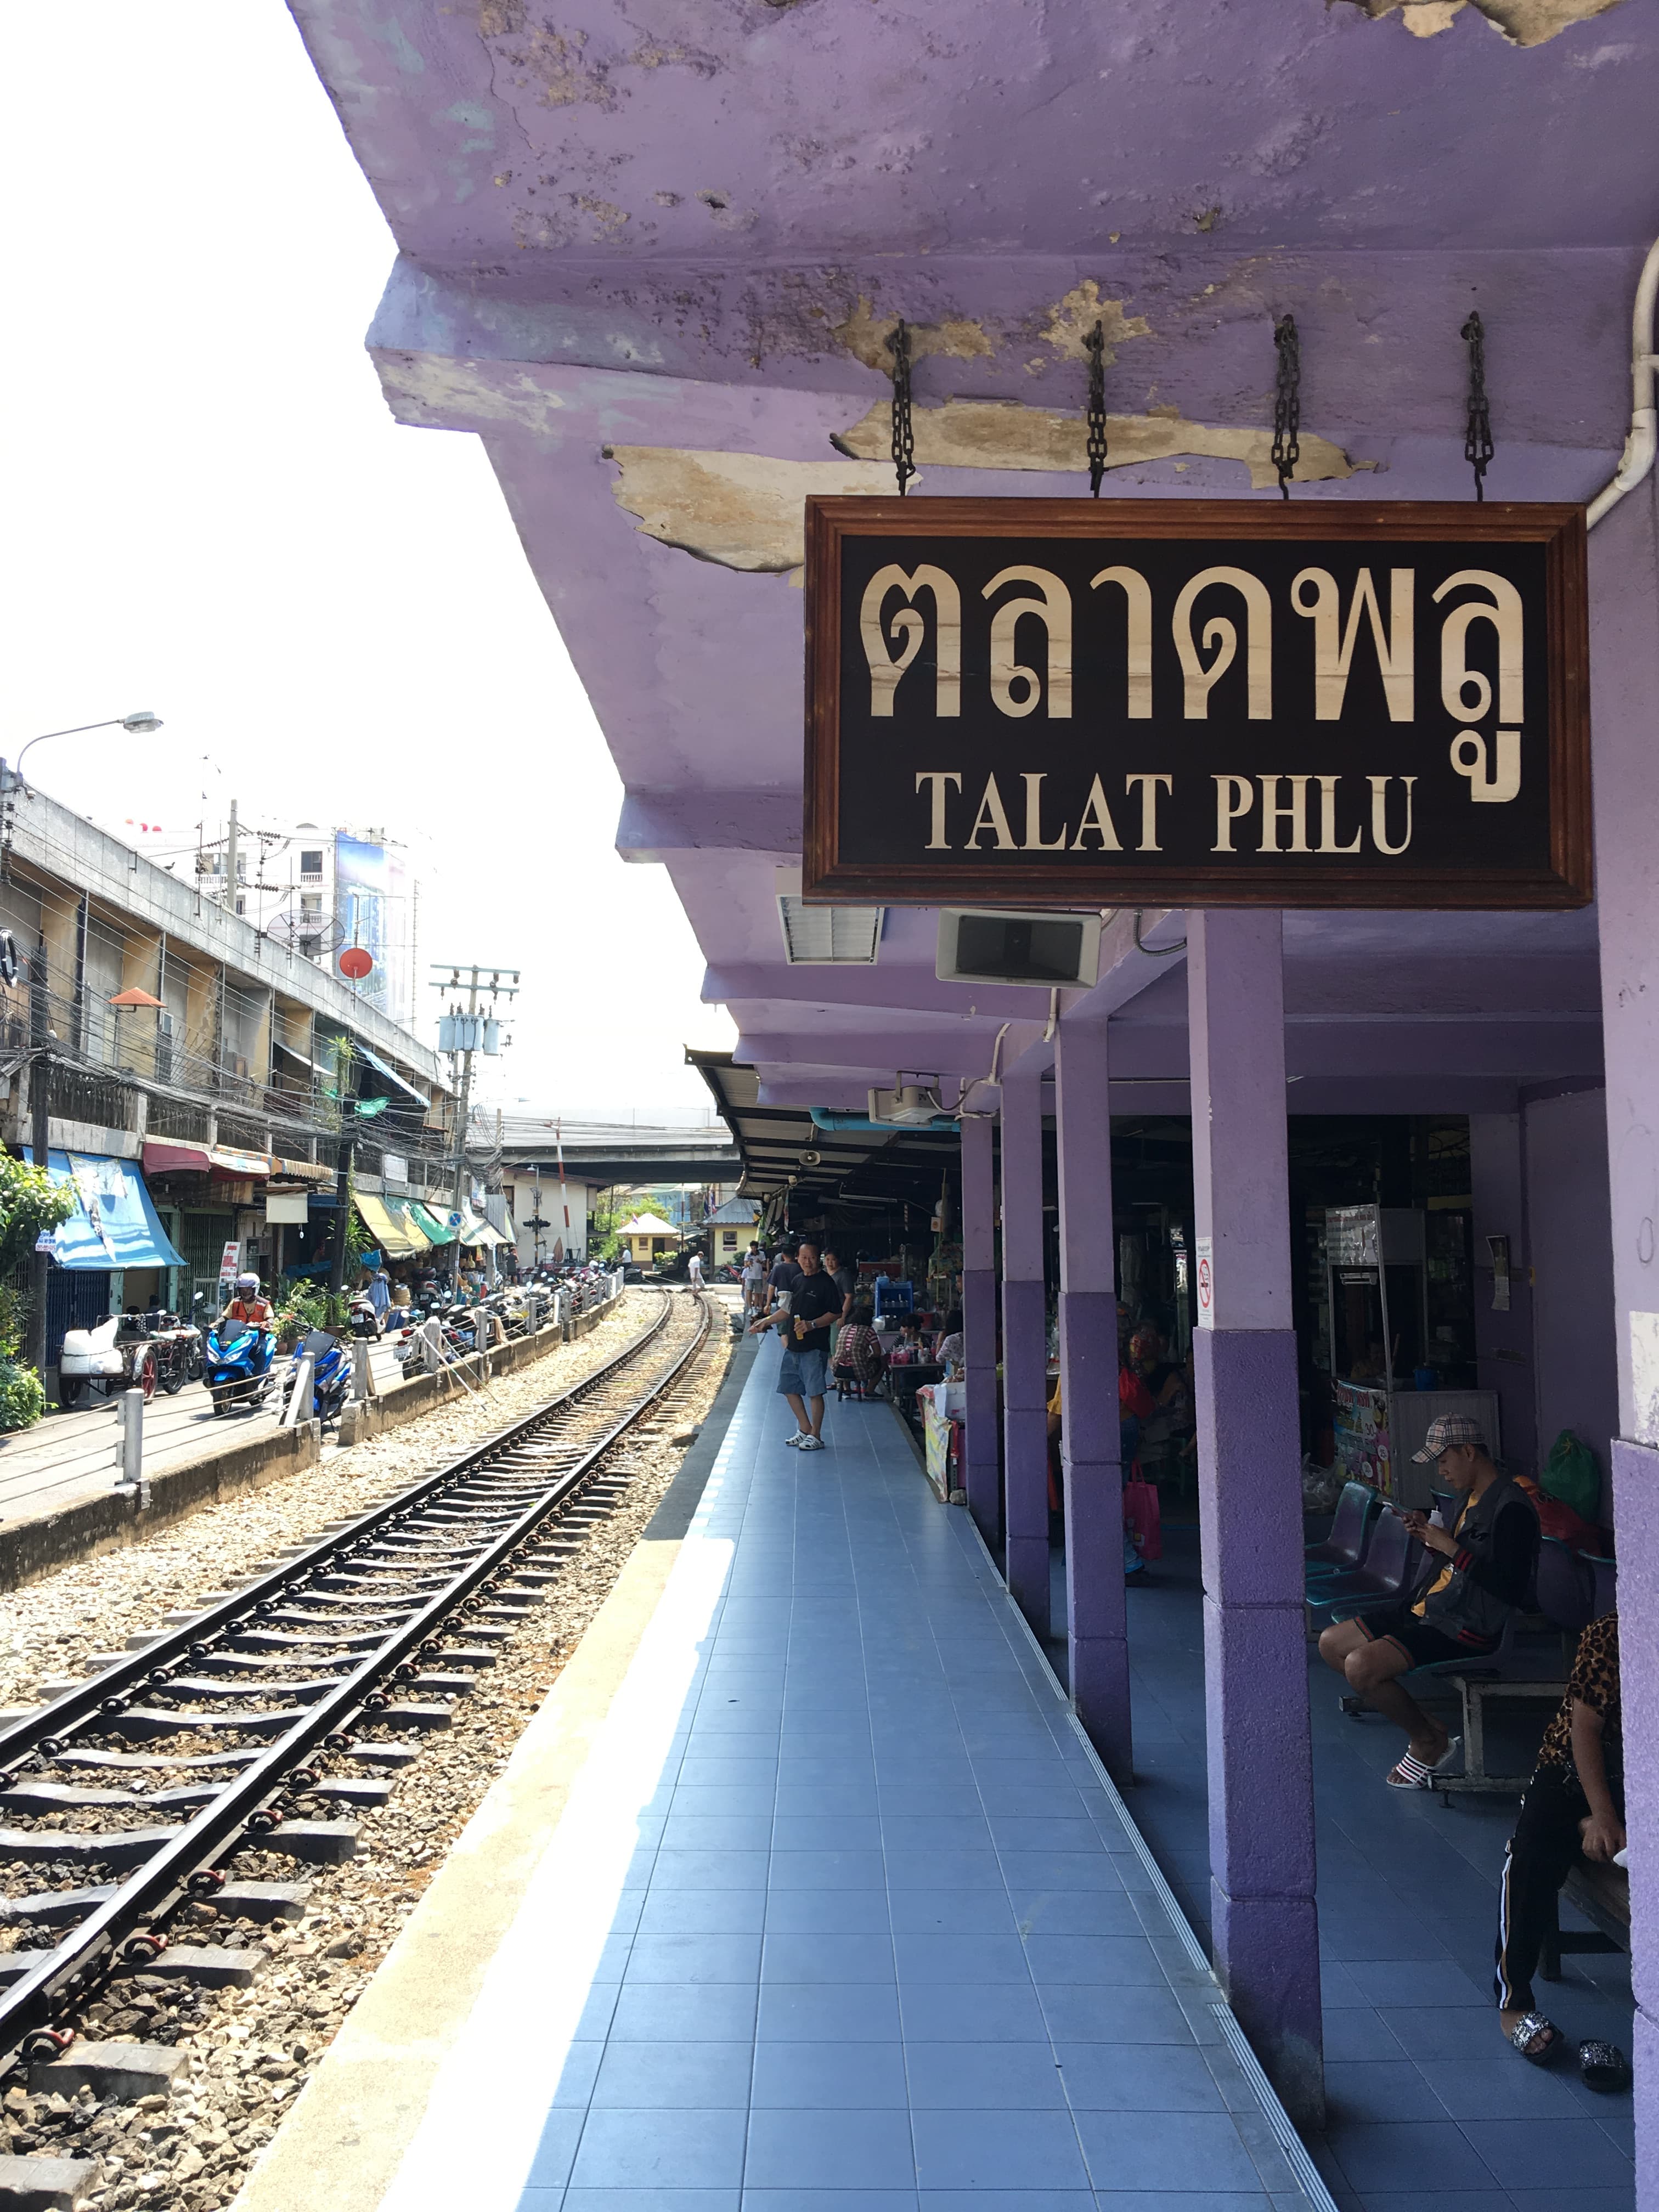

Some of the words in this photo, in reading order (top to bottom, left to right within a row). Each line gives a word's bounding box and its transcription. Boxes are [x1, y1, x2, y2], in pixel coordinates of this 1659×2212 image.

[860, 563, 1524, 803] ตลาดพลู
[916, 771, 1172, 851] TALAT
[1209, 775, 1418, 855] PHLU
